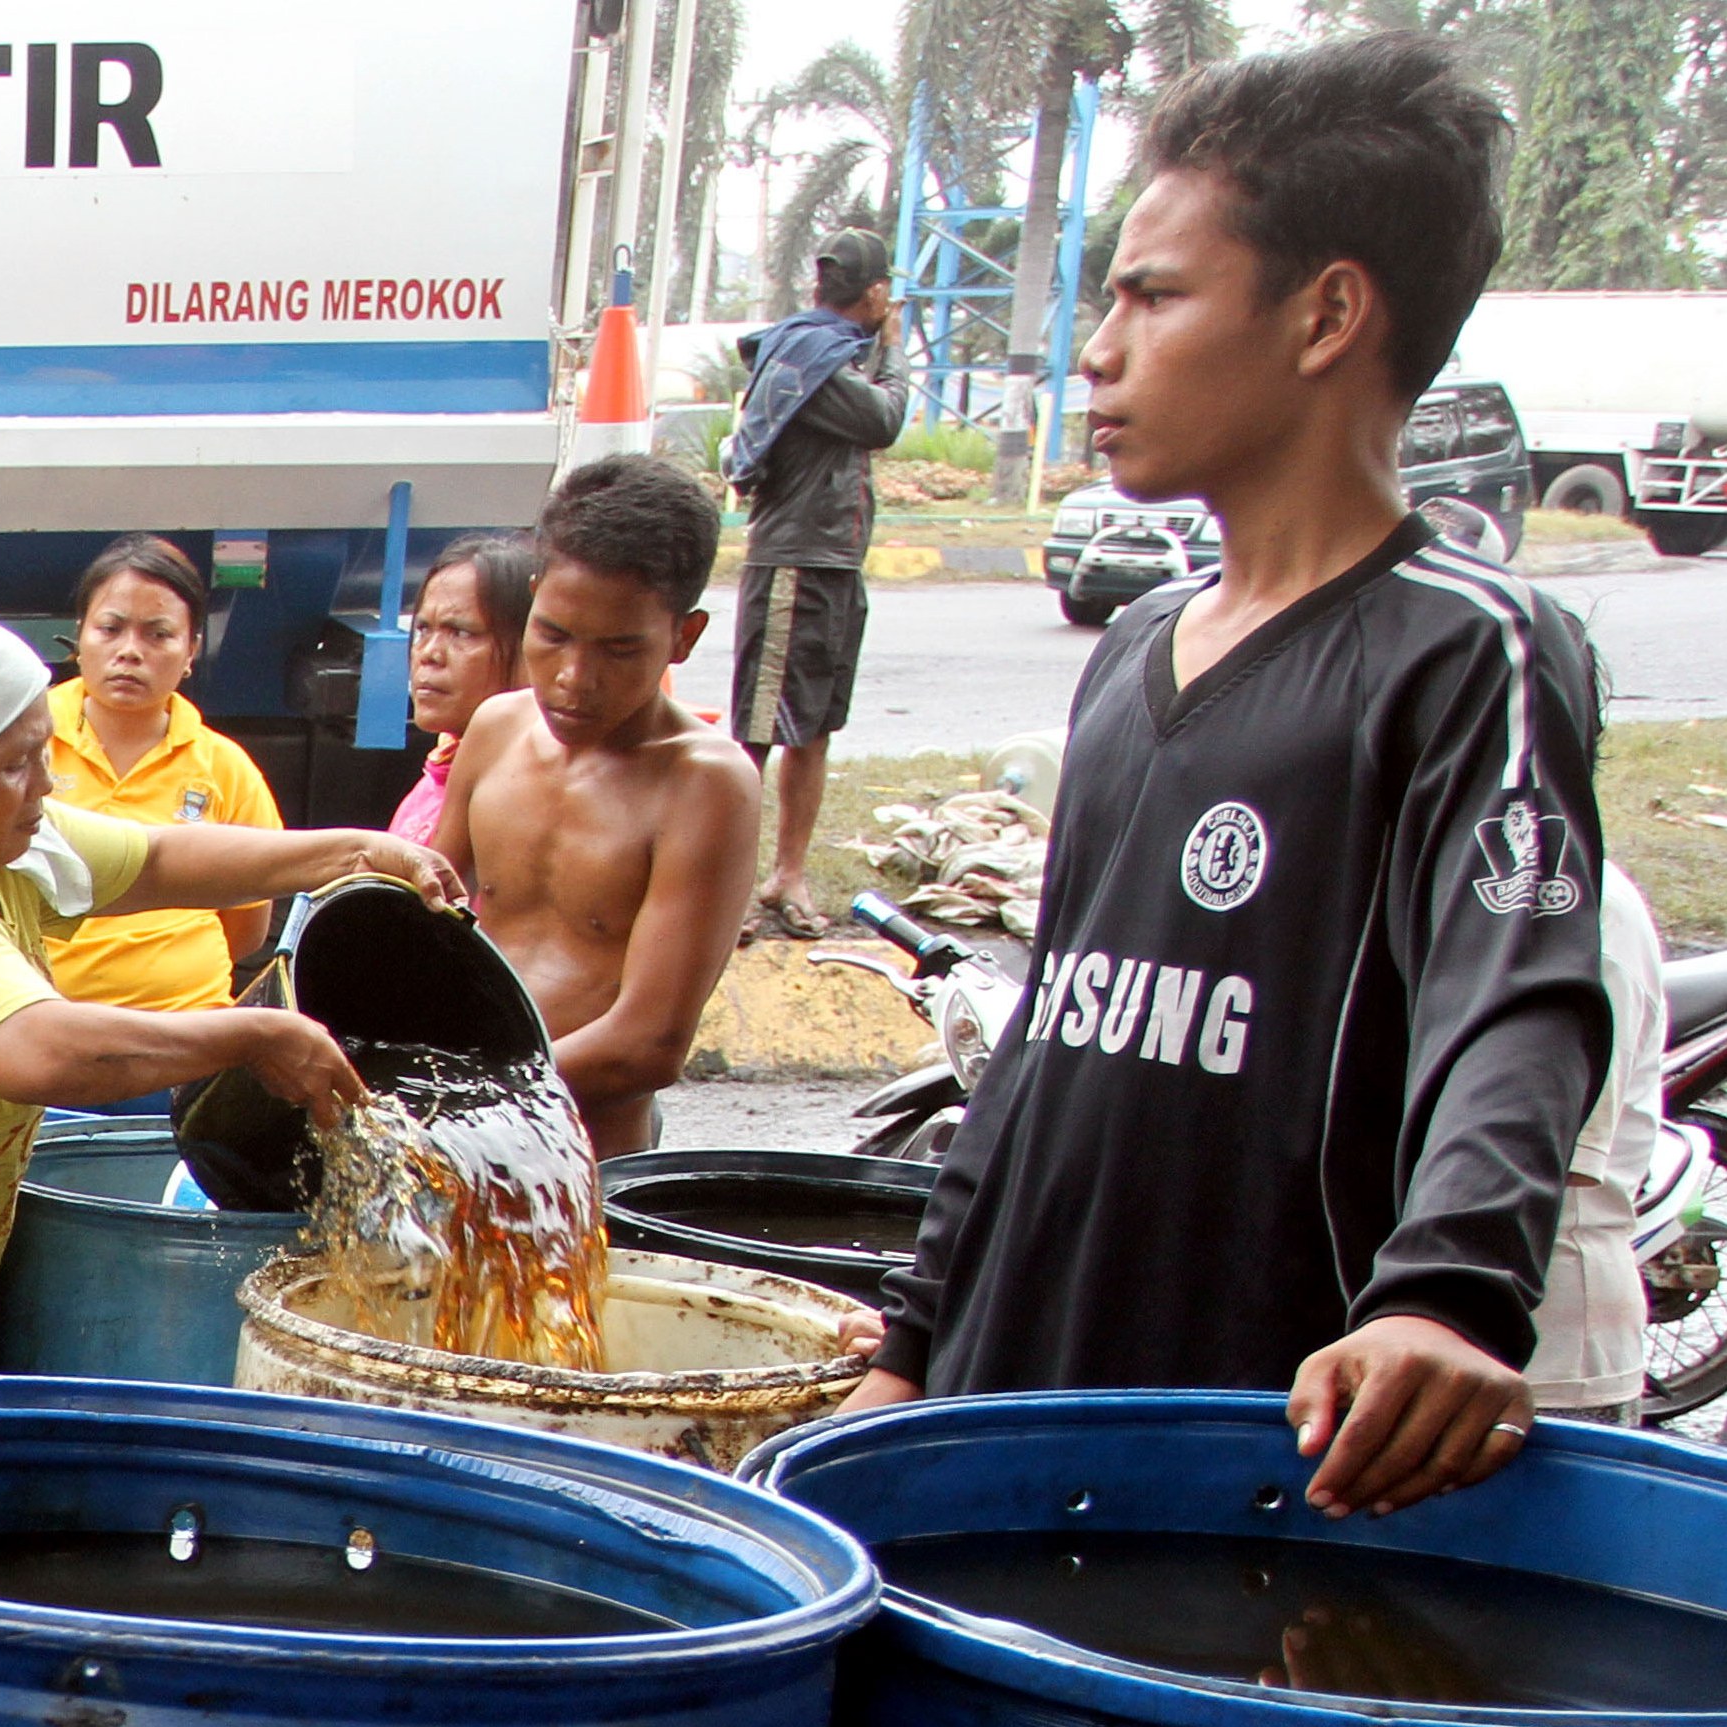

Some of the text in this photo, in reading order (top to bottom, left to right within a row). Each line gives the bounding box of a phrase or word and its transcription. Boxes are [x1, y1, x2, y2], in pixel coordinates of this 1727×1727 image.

[125, 278, 505, 325] DILARANG MEROKOK
[1206, 808, 1259, 843] CHELSEA
